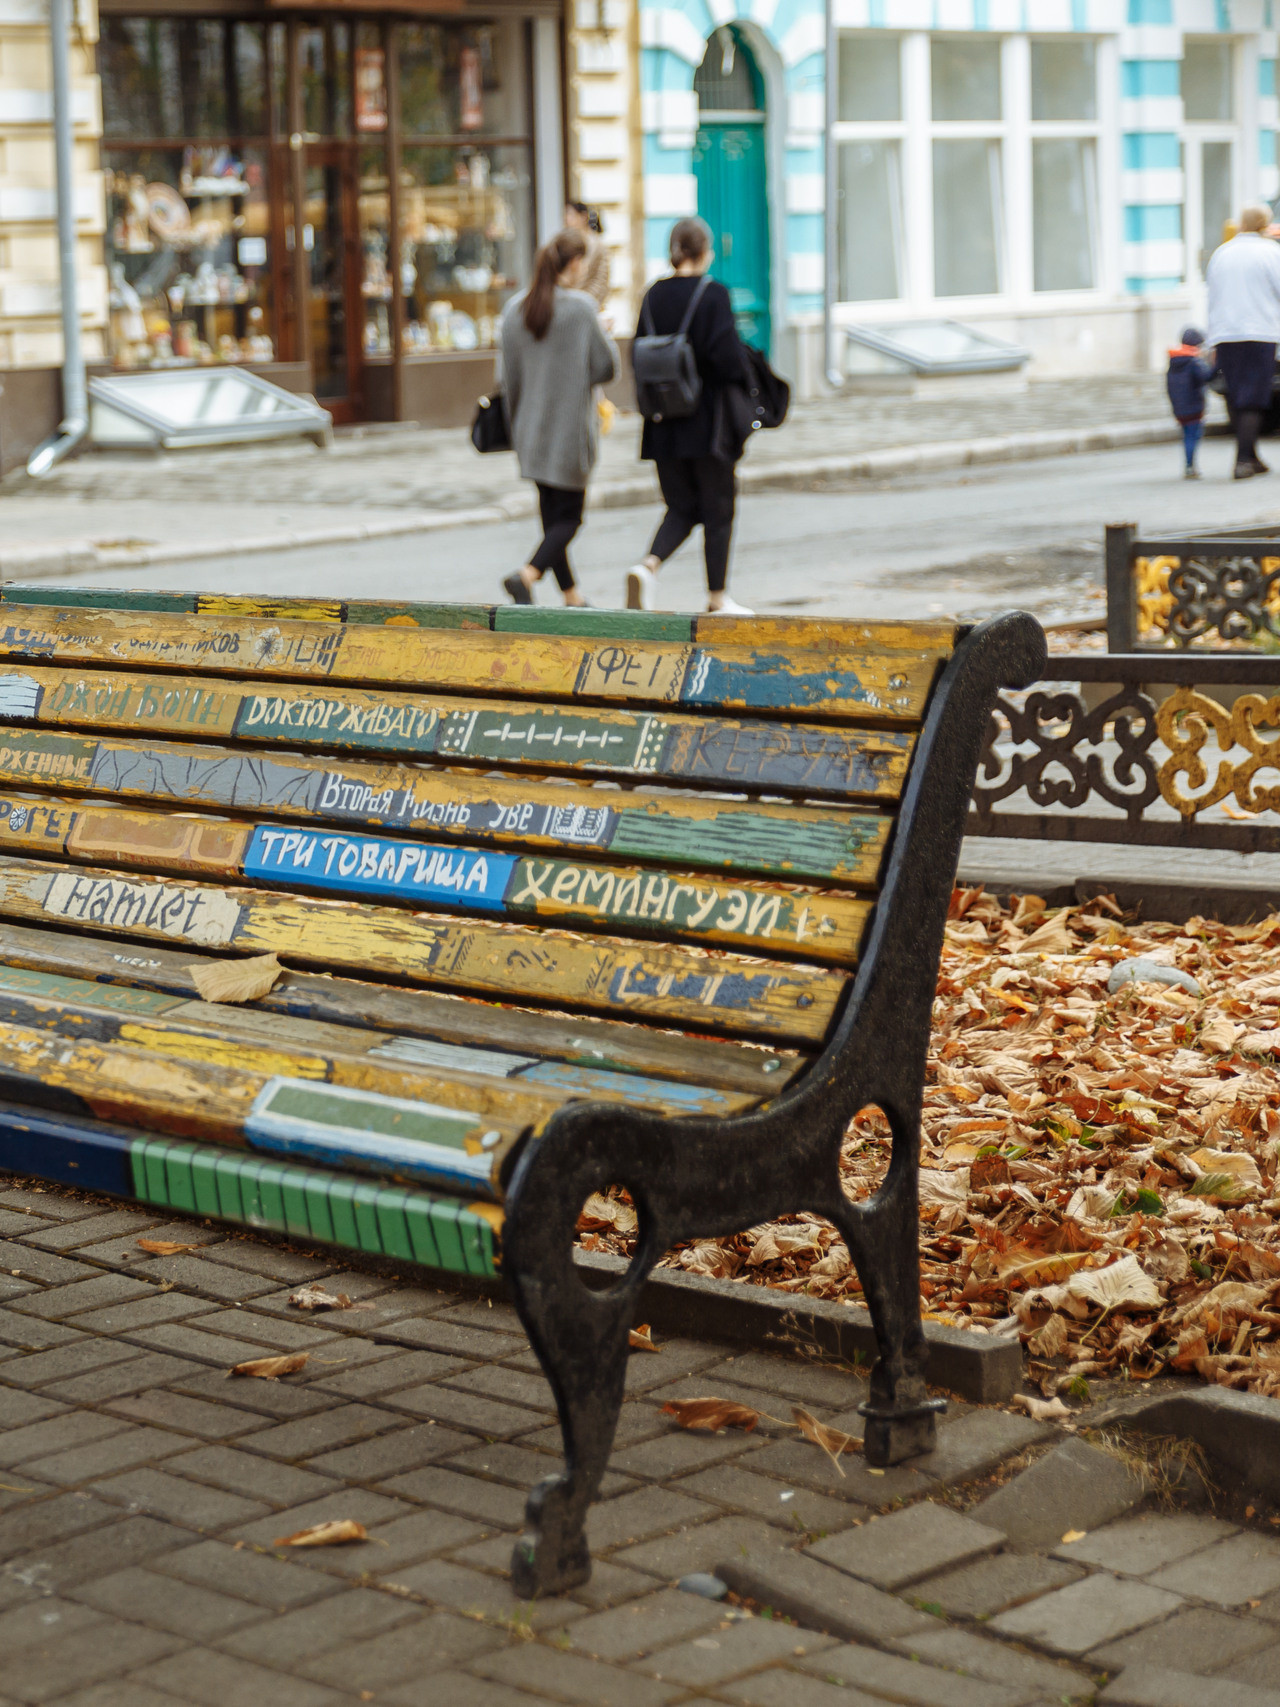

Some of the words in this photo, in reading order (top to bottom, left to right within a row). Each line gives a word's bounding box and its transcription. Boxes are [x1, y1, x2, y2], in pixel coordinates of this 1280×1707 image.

[245, 695, 345, 730] ДОКТОР
[260, 830, 318, 867] ТРИ
[321, 837, 489, 893] ТОВАРИЩА
[60, 876, 211, 934] Hamlet
